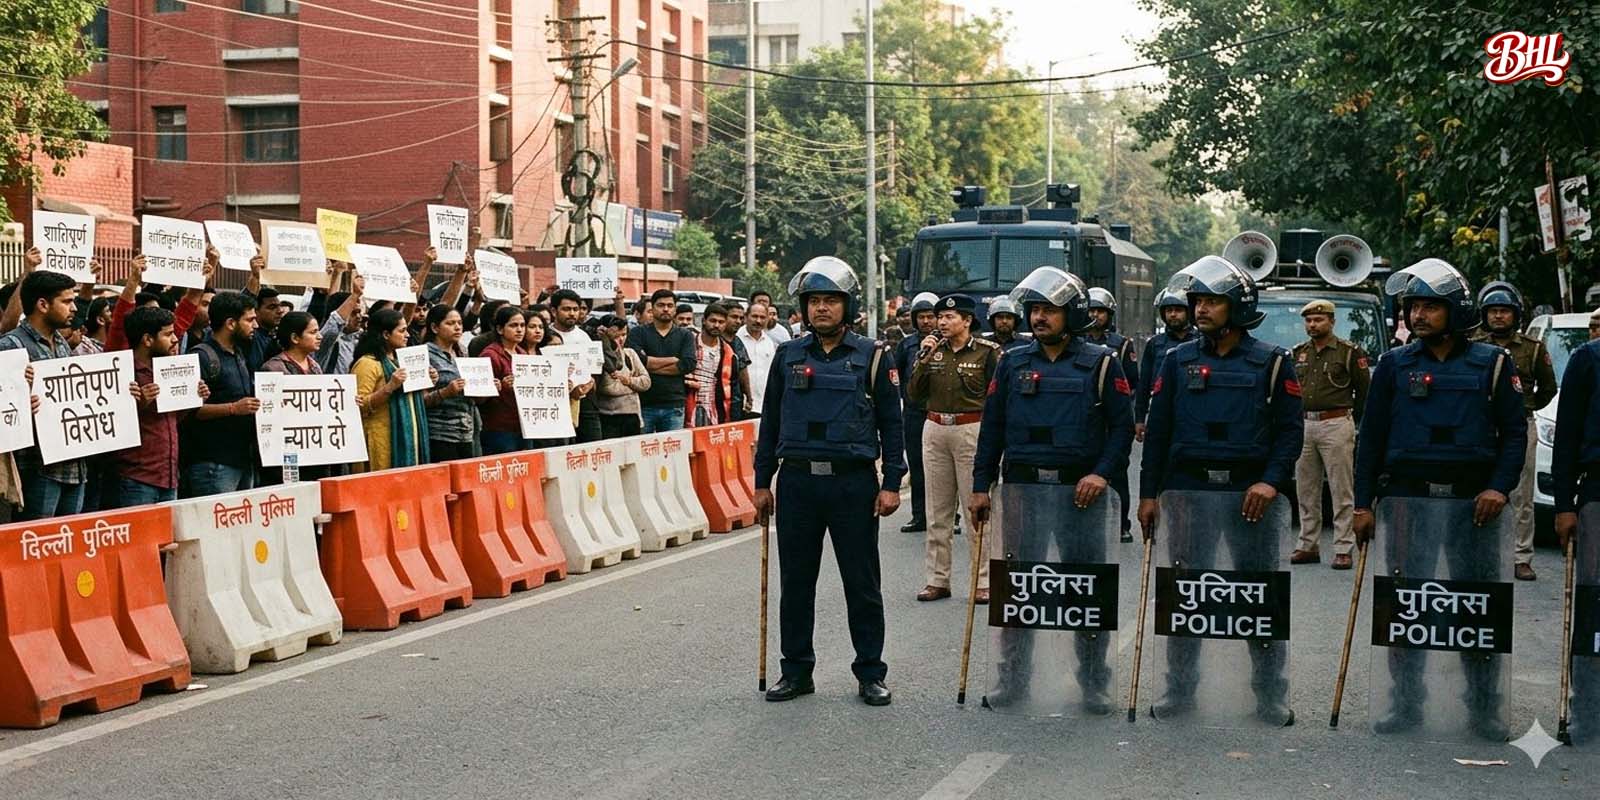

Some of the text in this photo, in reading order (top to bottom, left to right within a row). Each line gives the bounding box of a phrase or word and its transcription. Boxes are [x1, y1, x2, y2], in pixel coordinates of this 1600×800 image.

[42, 357, 120, 406] शांतिपूर्ण
[282, 388, 322, 412] न्याय
[327, 378, 345, 414] दो
[61, 404, 115, 446] विरोध
[283, 415, 346, 450] न्याय दो
[213, 494, 295, 528] दिल्ली पुलिस
[20, 519, 131, 560] दिल्ली पुलिस
[1009, 564, 1097, 602] पुलिस
[1176, 572, 1267, 611] पुलिस
[1395, 582, 1491, 620] पुलिस
[1003, 604, 1100, 627] POLICE
[1171, 612, 1272, 637] POLICE
[1388, 622, 1495, 649] POLICE
